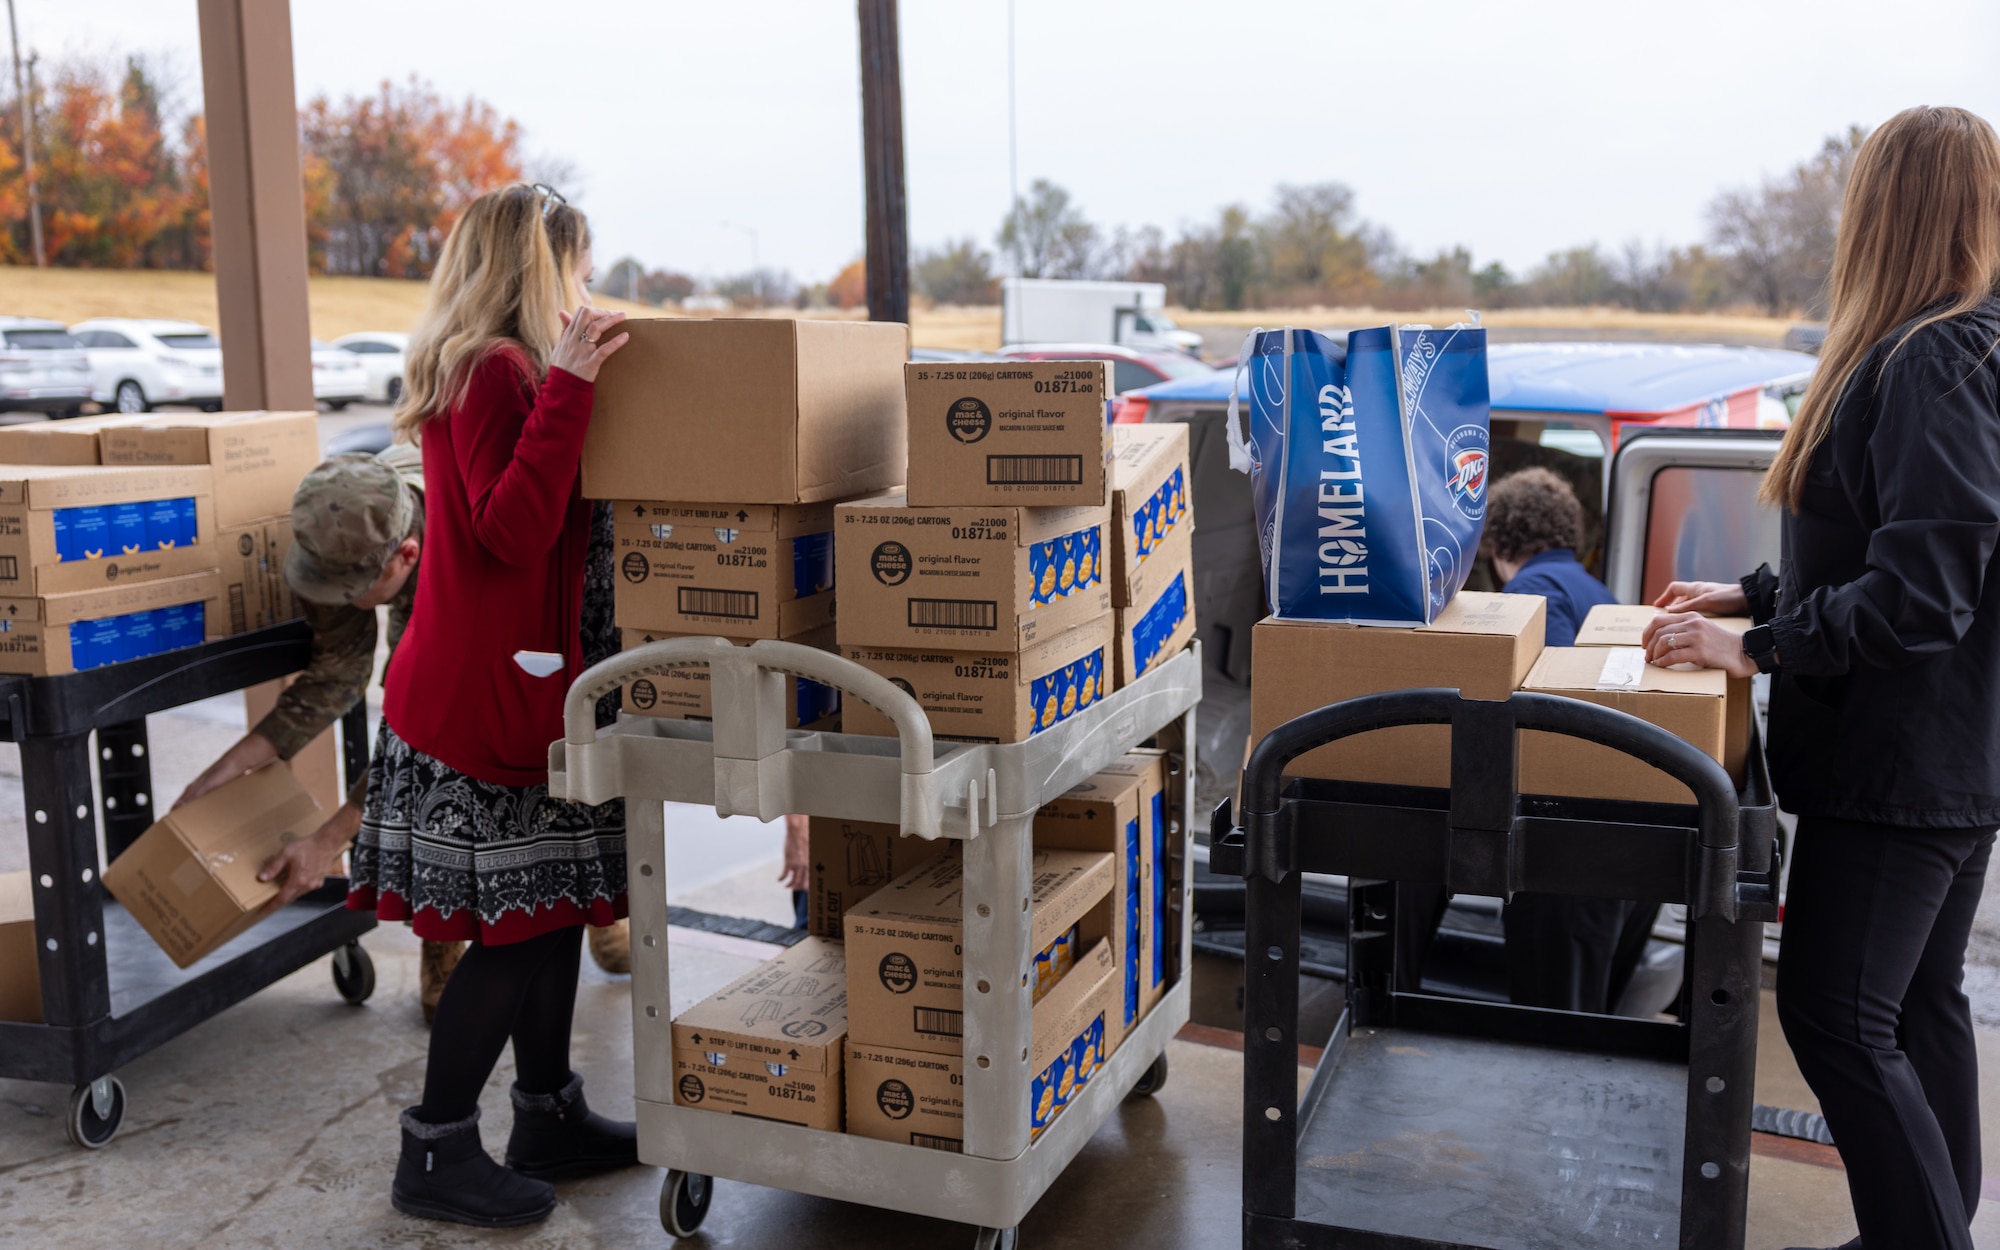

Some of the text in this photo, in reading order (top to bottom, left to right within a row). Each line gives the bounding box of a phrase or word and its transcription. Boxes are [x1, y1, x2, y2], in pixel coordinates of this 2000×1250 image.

[918, 372, 928, 380] 35
[936, 372, 954, 380] 7.25
[956, 372, 967, 380] OZ
[969, 371, 994, 380] (206g)
[997, 371, 1033, 380] CARTONS
[1404, 334, 1436, 416] LWAYS
[999, 409, 1065, 420] original flavor
[1450, 430, 1476, 449] OKLAHOMA
[1456, 457, 1483, 494] OKC
[1318, 384, 1369, 594] HOMELAND
[680, 509, 693, 517] LIFT
[695, 510, 709, 518] END
[711, 511, 729, 519] FLAP
[892, 516, 915, 525] (206g)
[917, 517, 951, 525] CARTONS
[663, 542, 684, 550] (206g)
[686, 542, 717, 552] CARTONS
[919, 555, 980, 565] original flavor
[896, 653, 919, 663] (206g)
[921, 654, 954, 663] CARTONS
[923, 691, 983, 701] original flavor
[898, 930, 919, 940] (206g)
[921, 932, 953, 942] CARTONS
[923, 968, 955, 978] original
[709, 1037, 725, 1045] STEP
[735, 1042, 748, 1050] LIFT
[764, 1047, 781, 1055] FLAP
[868, 1053, 882, 1062] 7.25
[895, 1057, 916, 1067] (206g)
[918, 1060, 949, 1071] CARTONS
[739, 1072, 768, 1083] CARTONS
[920, 1096, 963, 1108] original fla
